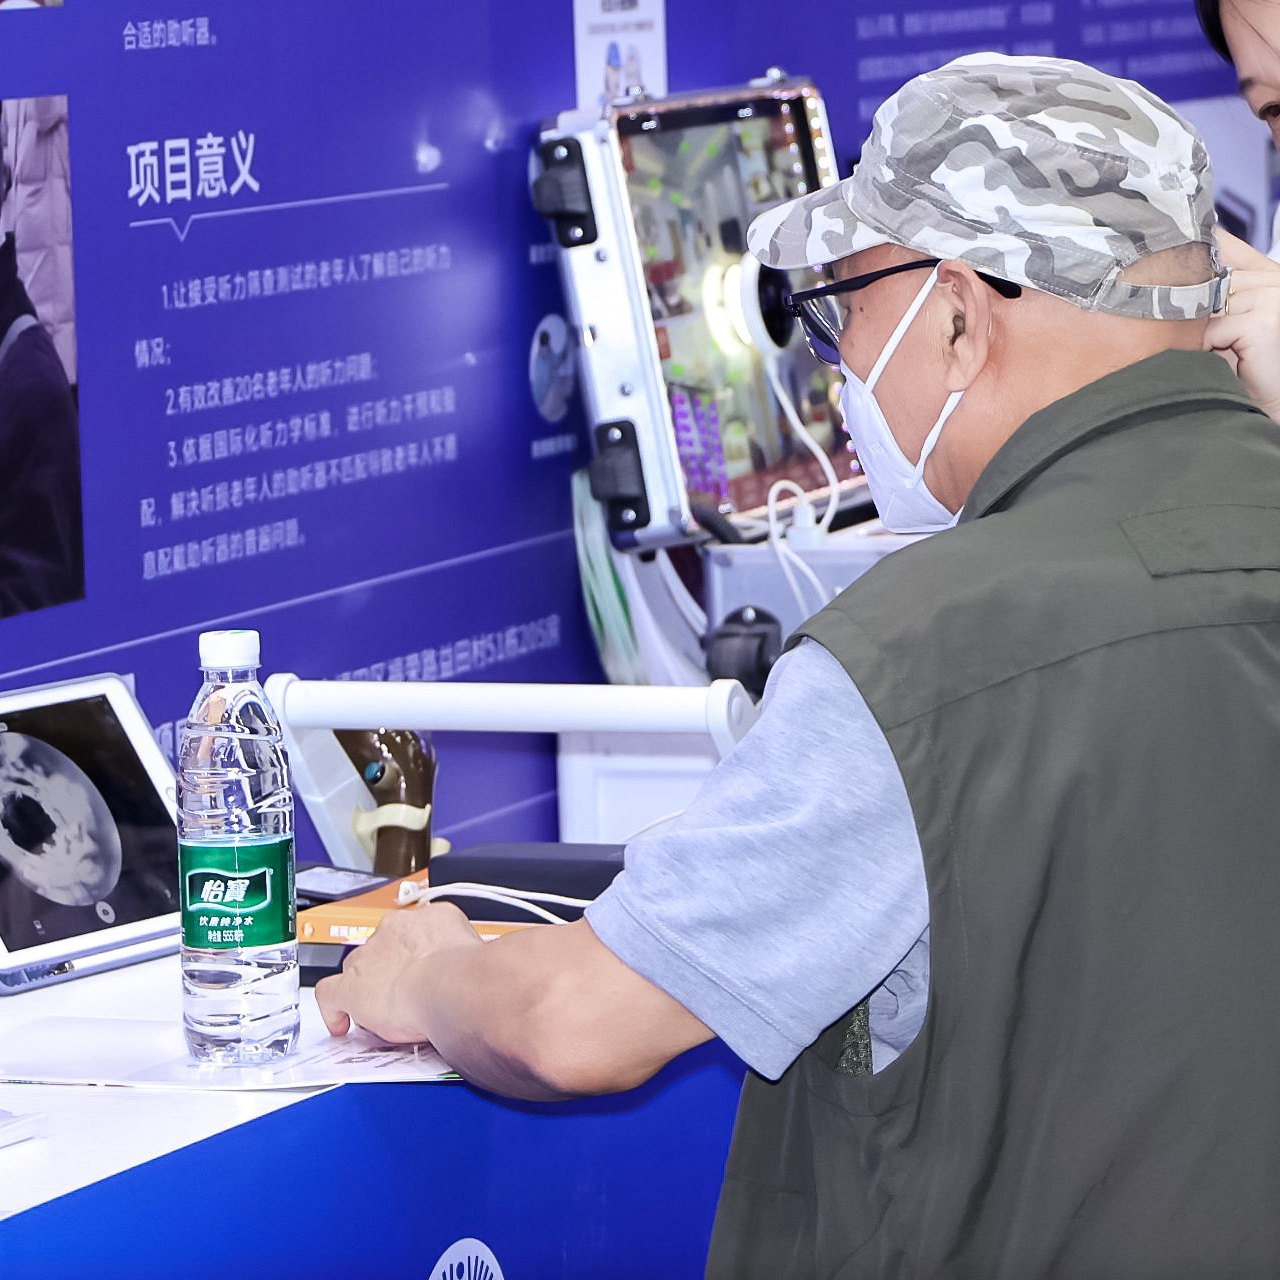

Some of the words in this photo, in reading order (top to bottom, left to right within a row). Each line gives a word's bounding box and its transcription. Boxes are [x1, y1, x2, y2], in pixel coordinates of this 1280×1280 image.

[127, 130, 260, 206] 项目意义
[200, 879, 250, 903] 怡寶
